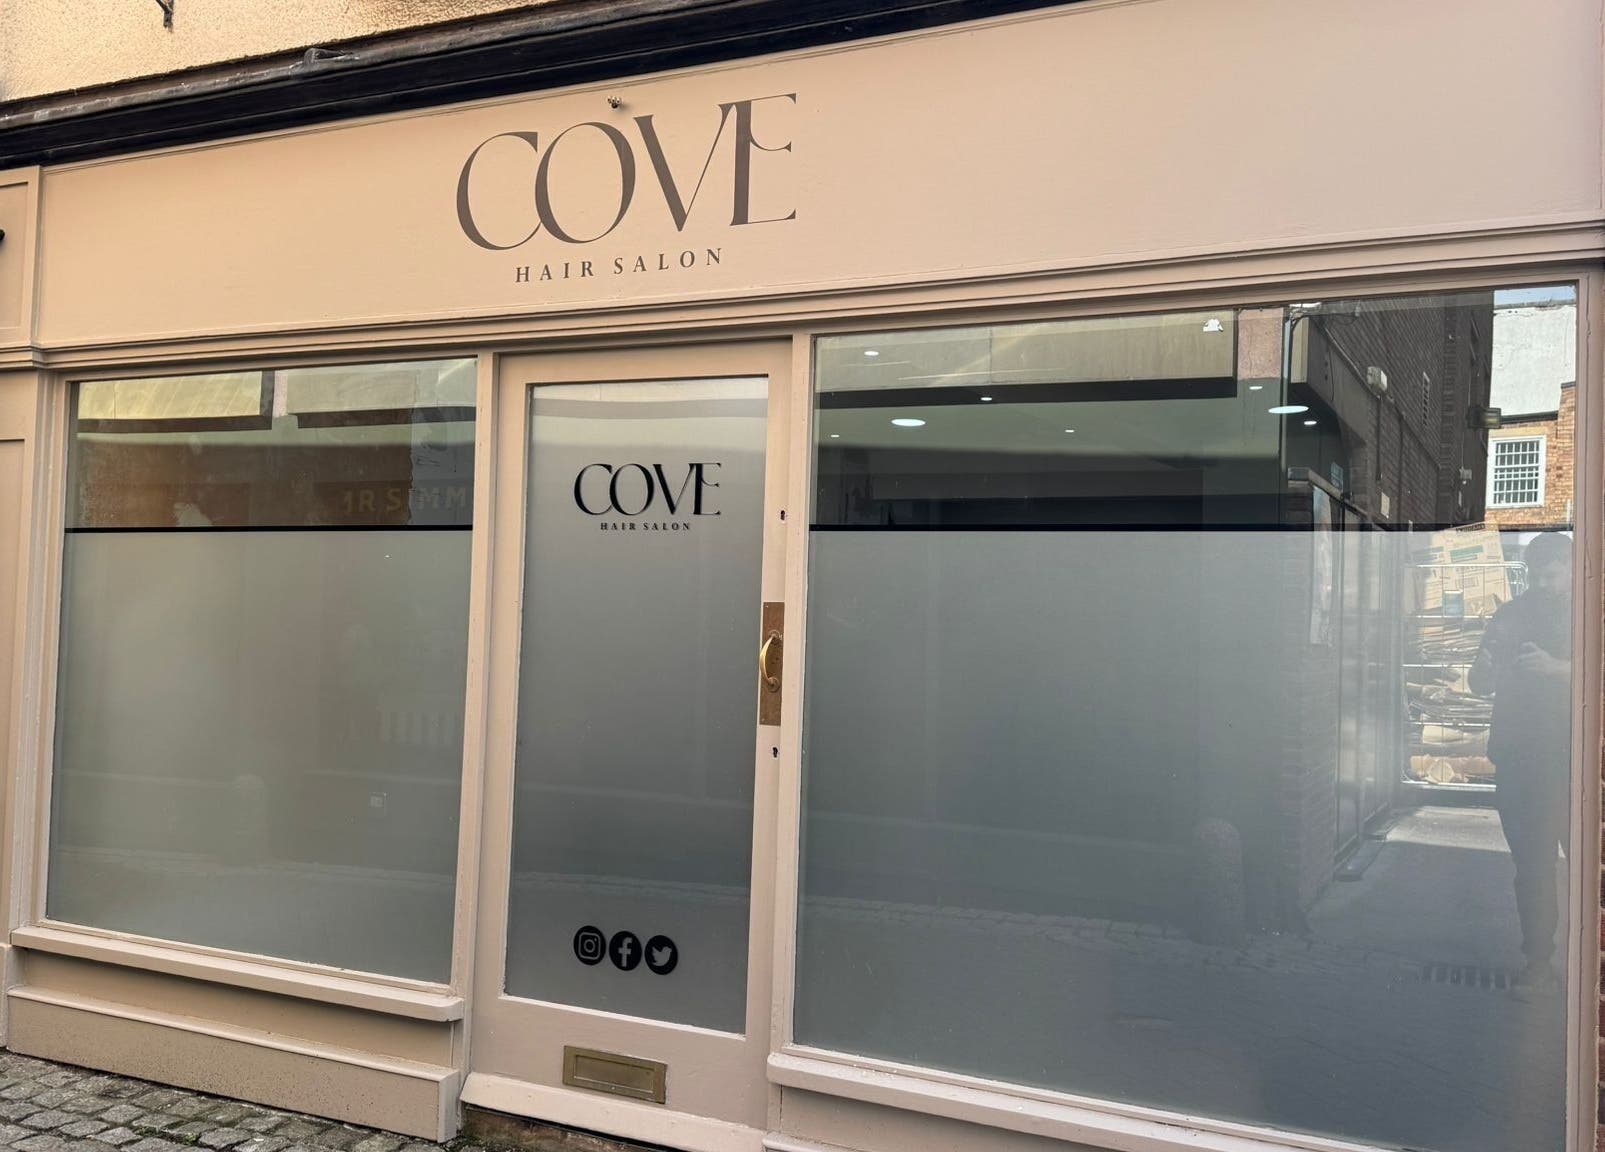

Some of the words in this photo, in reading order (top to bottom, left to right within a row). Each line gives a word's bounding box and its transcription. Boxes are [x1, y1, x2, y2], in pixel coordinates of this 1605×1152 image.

[456, 93, 797, 251] COVE
[515, 260, 594, 283] HAIR
[613, 247, 722, 275] SALON
[573, 462, 722, 516] COVE
[600, 522, 637, 531] HAIR
[642, 521, 691, 531] SALON
